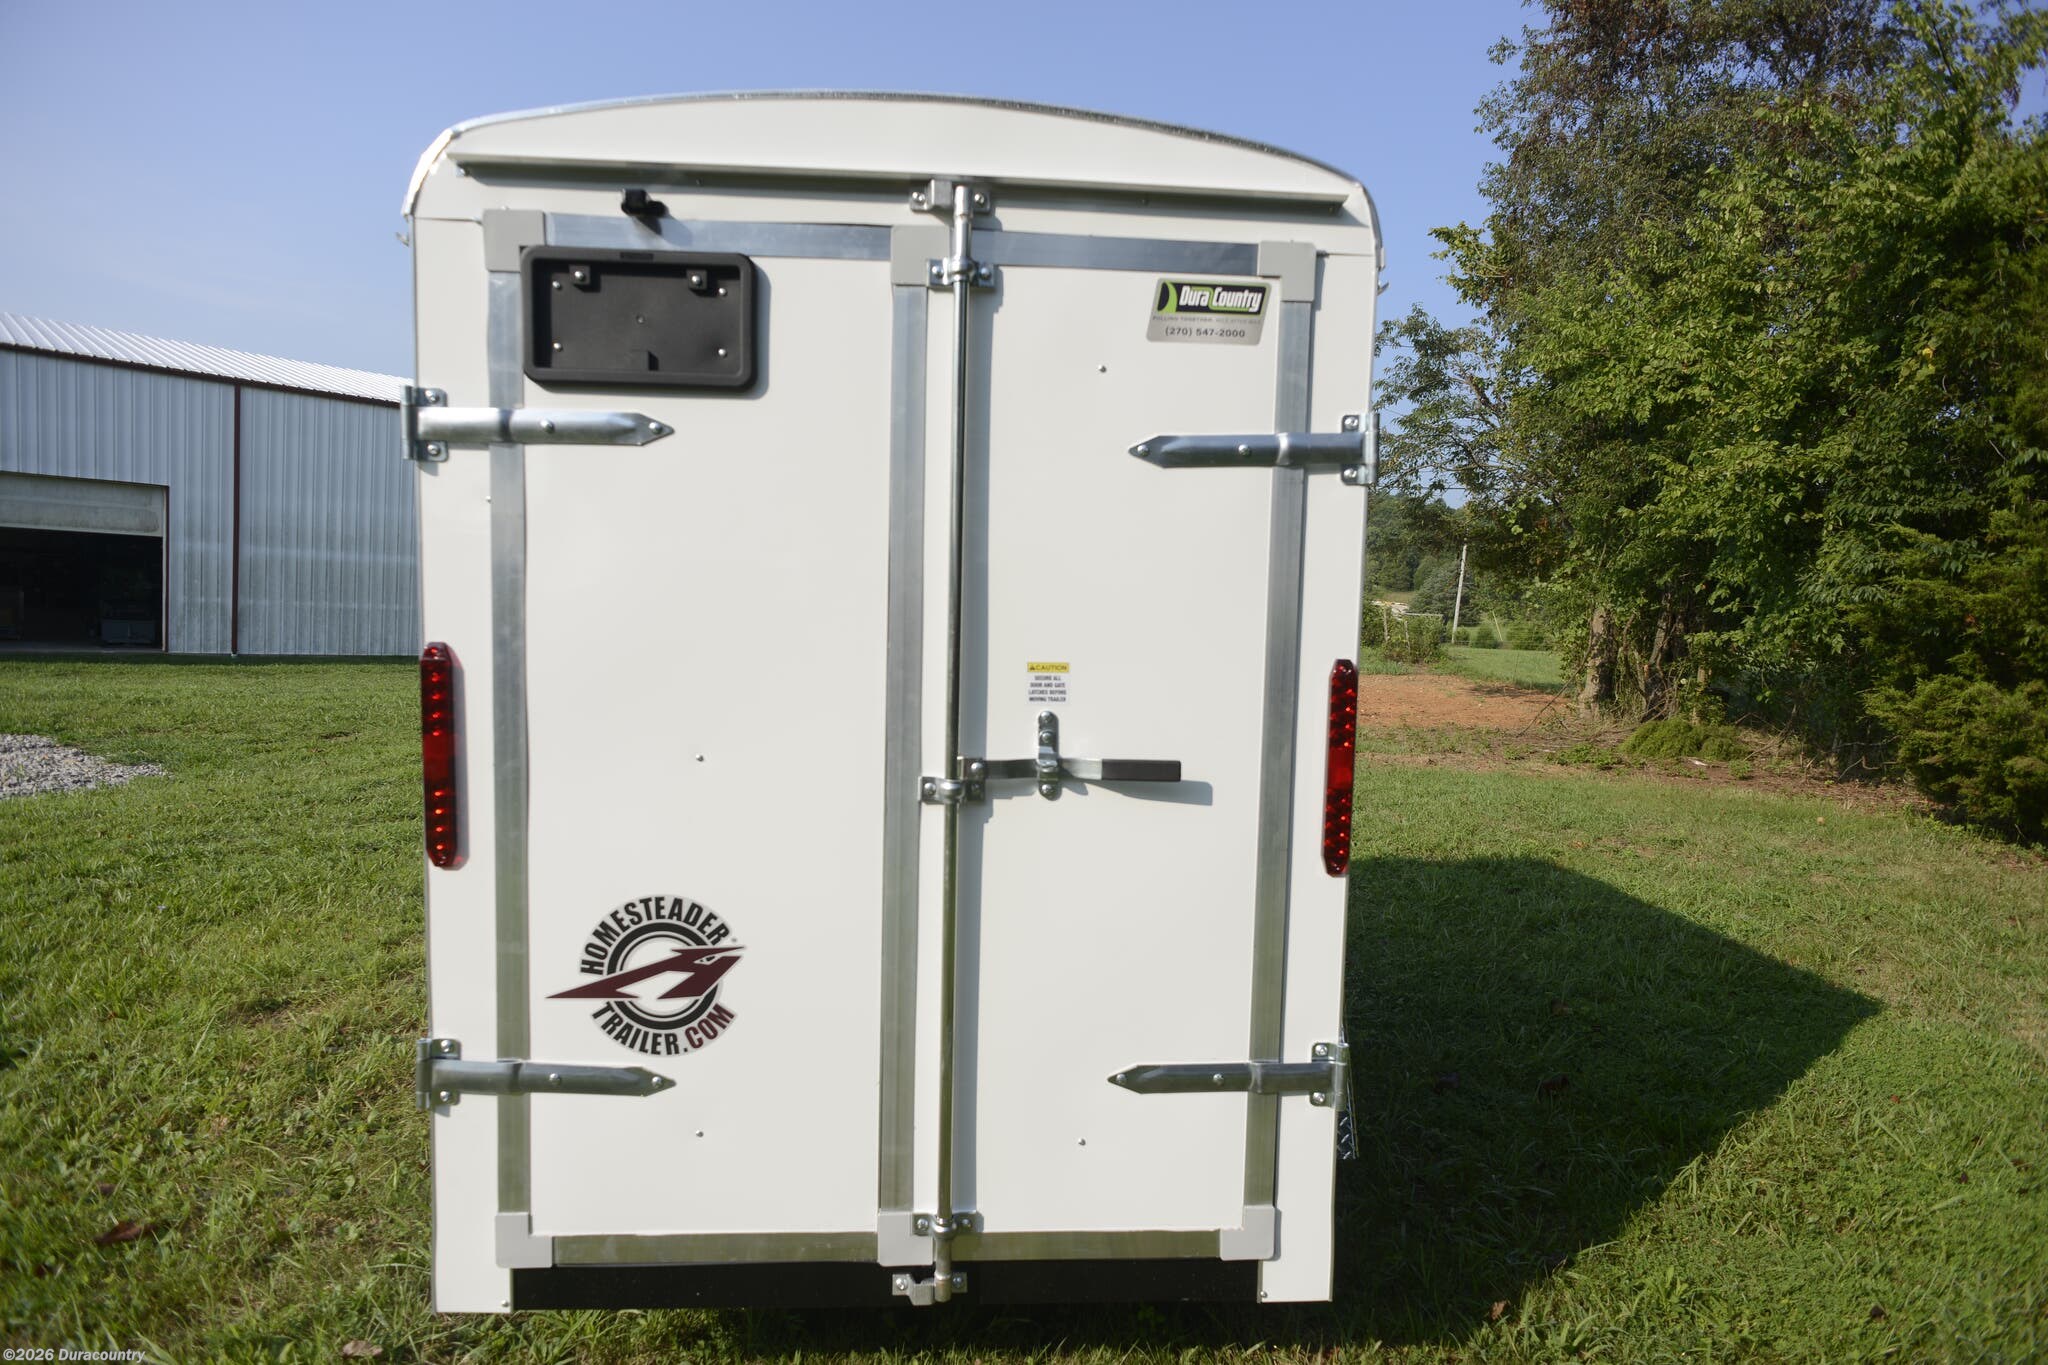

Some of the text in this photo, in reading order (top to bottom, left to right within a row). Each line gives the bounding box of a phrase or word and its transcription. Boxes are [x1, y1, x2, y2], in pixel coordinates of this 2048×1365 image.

[1179, 285, 1262, 313] Dura Country
[1165, 326, 1246, 338] (270) 547-2000
[580, 896, 730, 975] HOMESTEADER
[592, 1000, 735, 1055] TRAILER.COM
